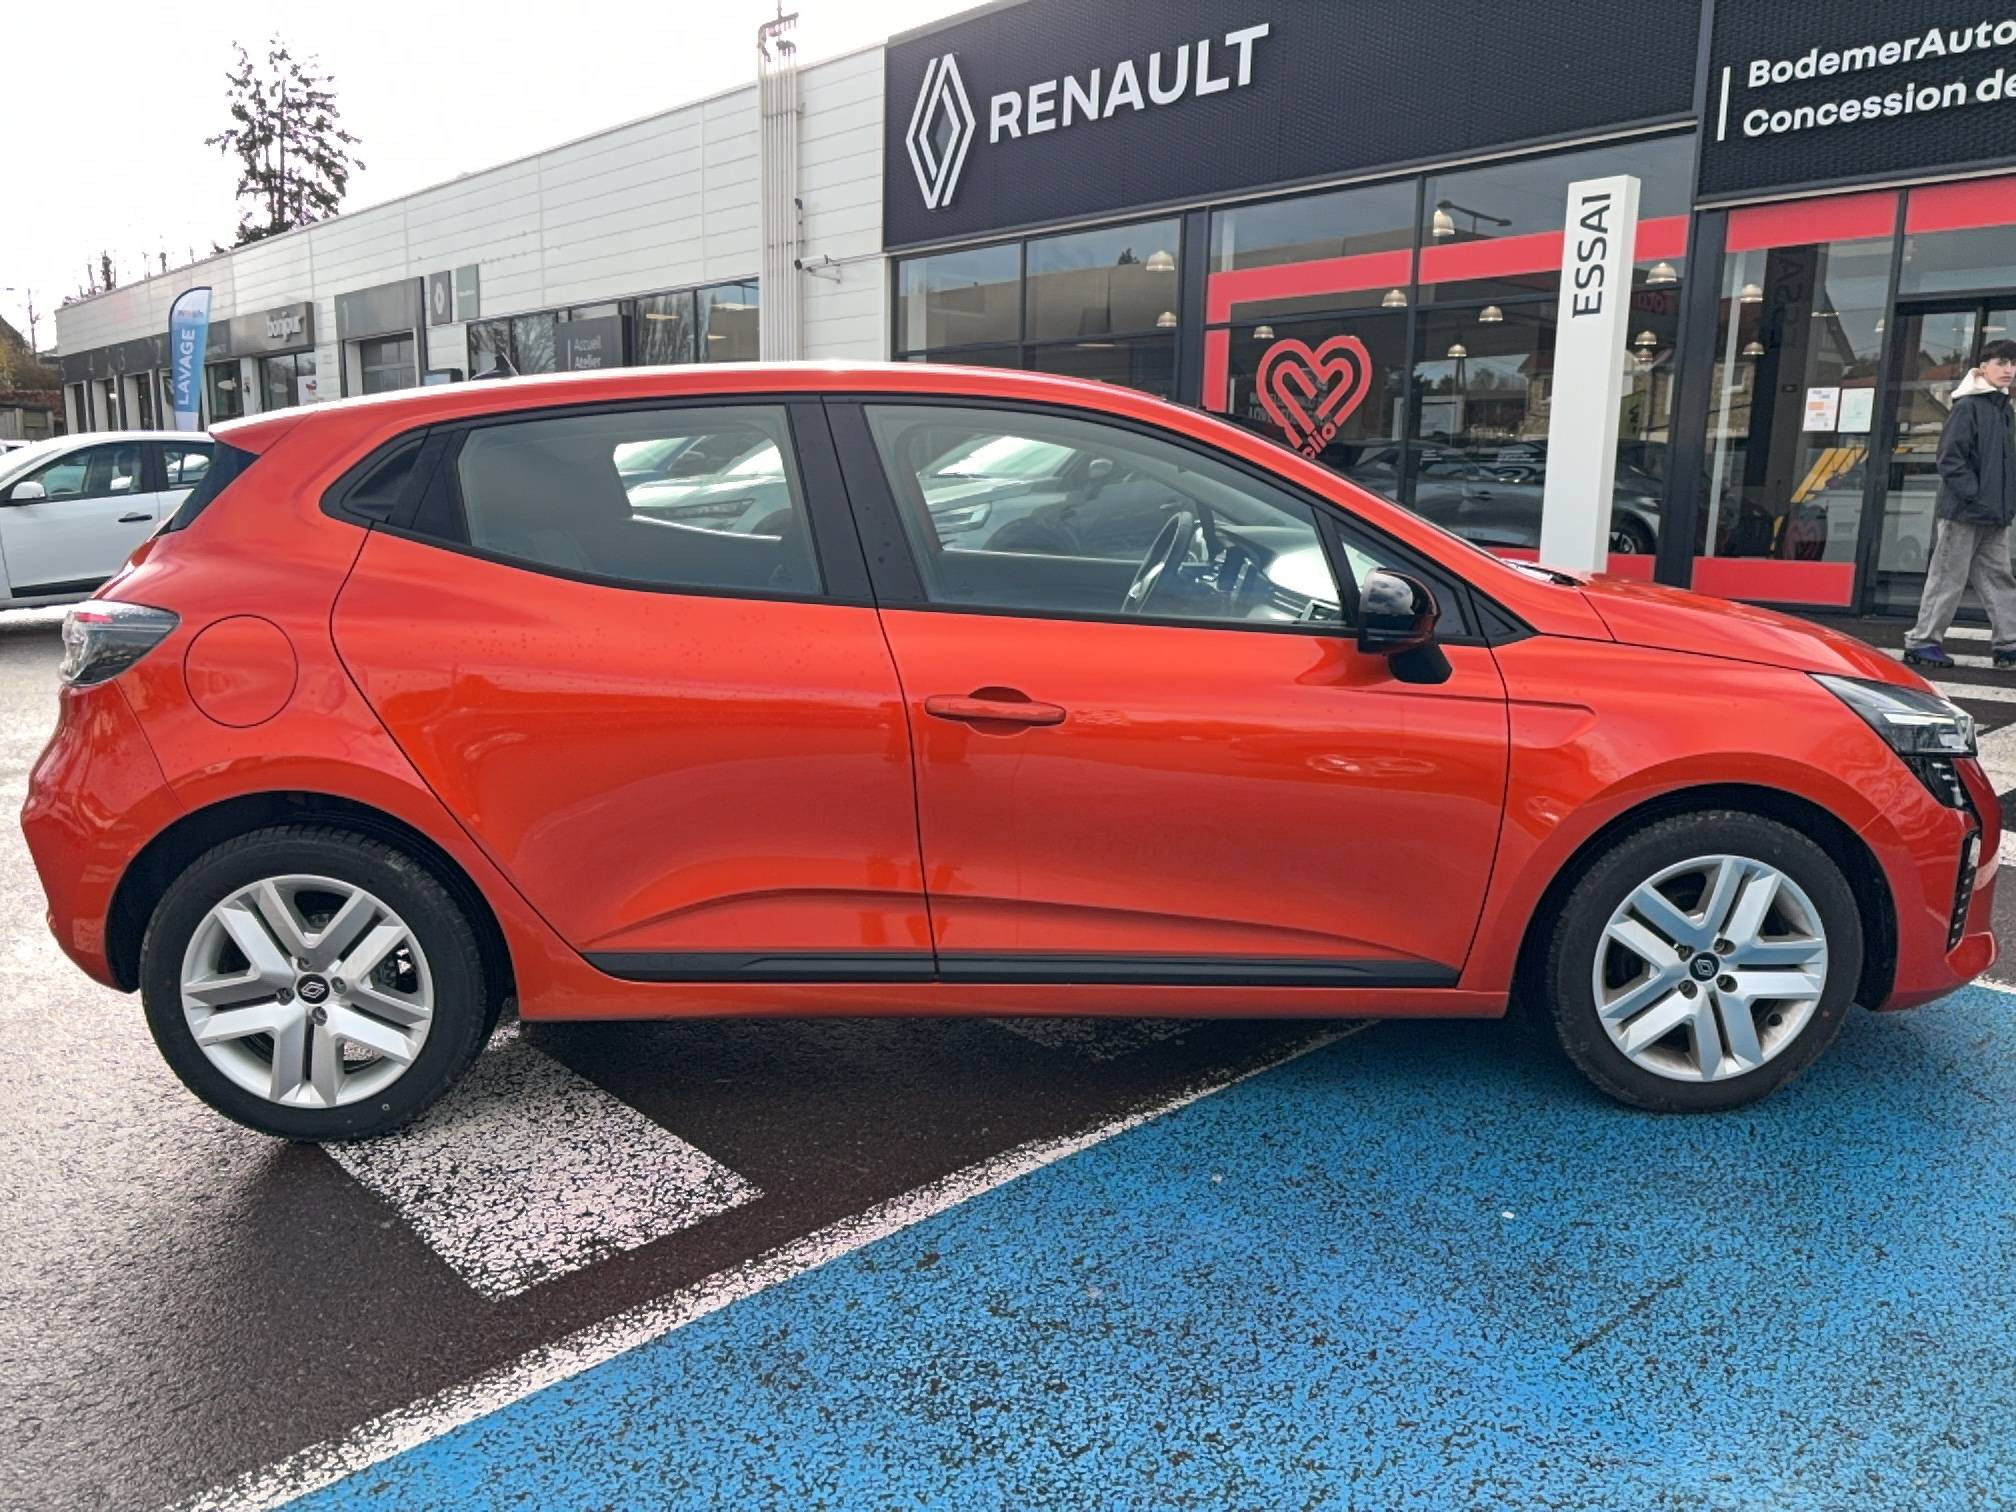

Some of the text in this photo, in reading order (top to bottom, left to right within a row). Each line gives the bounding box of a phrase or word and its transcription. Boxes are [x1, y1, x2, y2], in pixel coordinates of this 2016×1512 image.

[989, 23, 1270, 144] RENAULT
[1743, 82, 1967, 137] Concession
[1572, 193, 1612, 319] ESSAI
[178, 328, 196, 406] LAVAGE
[1302, 421, 1337, 460] clio
